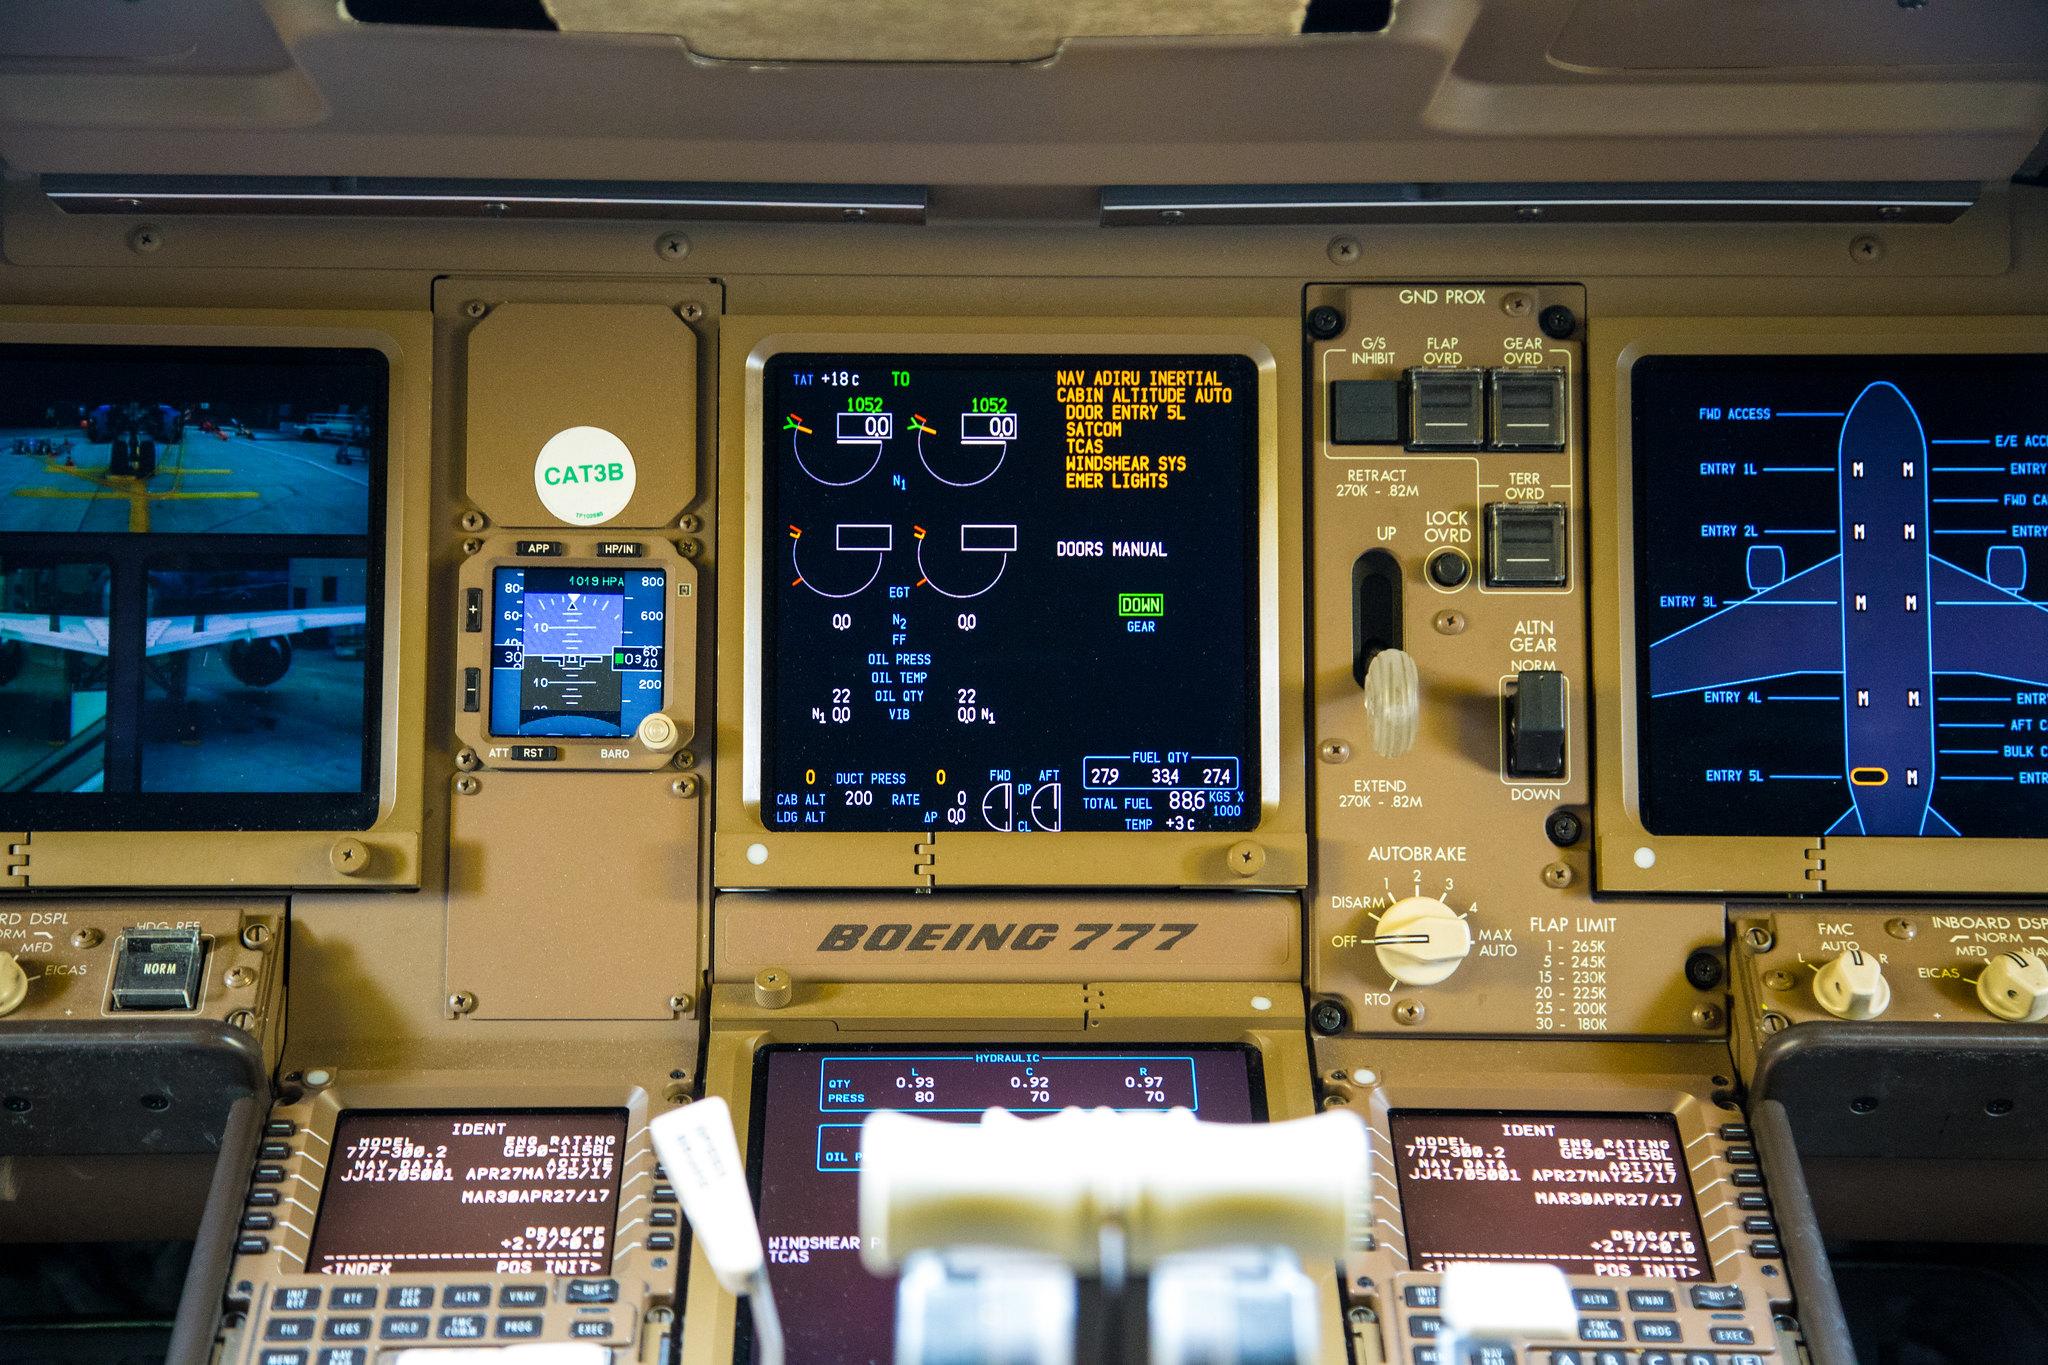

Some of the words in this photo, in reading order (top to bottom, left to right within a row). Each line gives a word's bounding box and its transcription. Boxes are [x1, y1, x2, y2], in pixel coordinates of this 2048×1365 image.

[1400, 290, 1437, 304] GND
[1446, 290, 1485, 304] PROX
[1362, 337, 1386, 349] G/S
[1427, 338, 1458, 349] FLAP
[1504, 338, 1542, 349] GEAR
[1352, 353, 1394, 364] INHIBIT
[1424, 353, 1462, 365] OVRD
[1504, 353, 1542, 365] OVRD
[794, 374, 813, 385] TAT
[892, 372, 910, 387] TO
[1057, 370, 1084, 385] NAV
[1094, 371, 1140, 385] ADIRU
[1150, 371, 1222, 386] INERTIAL
[1057, 388, 1103, 403] CABIN
[1112, 388, 1185, 403] ALTITUDE
[1195, 388, 1232, 403] AUTO
[1066, 405, 1103, 420] DOOR
[1112, 405, 1158, 420] ENTRY
[1167, 405, 1185, 420] 5L
[1700, 409, 1722, 419] FWD
[1728, 409, 1771, 419] ACCESS
[1066, 422, 1122, 437] SATCOM
[1066, 439, 1103, 454] TCAS
[1995, 435, 2018, 447] E/E
[1066, 456, 1149, 471] WINDSHEAR
[1158, 456, 1186, 471] SYS
[1700, 463, 1735, 475] ENTRY
[1744, 463, 1757, 475] 1L
[2010, 463, 2047, 475] ENTRY
[544, 463, 624, 486] CAT3B
[1348, 470, 1406, 481] RETRACT
[1509, 473, 1540, 484] TERR
[1066, 473, 1103, 488] EMER
[1112, 473, 1168, 488] LIGHTS
[1337, 485, 1367, 496] 270K
[1505, 488, 1544, 499] OVRD
[2004, 494, 2027, 506] FWD
[1426, 511, 1468, 525] LOCK
[1377, 527, 1396, 540] UP
[1424, 528, 1471, 542] OVRD
[1702, 526, 1736, 536] ENTRY
[1744, 526, 1758, 537] 2L
[528, 544, 549, 553] APP
[605, 545, 633, 554] HP/IN
[1057, 541, 1103, 556] DOORS
[1112, 542, 1167, 557] MANUAL
[569, 576, 599, 586] 1019
[602, 577, 624, 586] HPA
[641, 577, 664, 586] 800
[890, 587, 910, 597] EGT
[1122, 598, 1159, 612] DOWN
[1660, 596, 1695, 607] ENTRY
[1703, 596, 1717, 607] 3L
[641, 612, 663, 621] 600
[1127, 621, 1155, 632] GEAR
[1514, 621, 1554, 634] ALTN
[1510, 638, 1556, 652] GEAR
[868, 654, 889, 665] OIL
[896, 654, 931, 665] PRESS
[1511, 660, 1555, 671] NORM
[872, 673, 892, 683] OIL
[900, 673, 927, 683] TEMP
[639, 680, 661, 689] 200
[875, 691, 895, 701] OIL
[903, 691, 923, 701] QTY
[1704, 692, 1740, 703] ENTRY
[1747, 692, 1761, 703] 4L
[889, 709, 910, 720] VIB
[2011, 719, 2032, 731] AFT
[489, 749, 509, 757] ATT
[524, 749, 543, 757] RST
[601, 749, 629, 758] BARO
[2004, 746, 2034, 757] BULK
[1133, 752, 1160, 763] FUEL
[1168, 752, 1189, 763] QTY
[836, 773, 864, 784] DUCT
[871, 773, 906, 784] PRESS
[990, 770, 1010, 780] FWD
[1039, 770, 1059, 780] AFT
[1706, 770, 1741, 781] ENTRY
[1749, 770, 1763, 781] 5L
[1354, 780, 1407, 792] EXTEND
[777, 794, 797, 805] CAB
[805, 794, 825, 805] ALT
[845, 791, 872, 805] 200
[892, 794, 920, 805] RATE
[1209, 792, 1230, 802] KGS
[1511, 789, 1560, 800] DOWN
[1083, 798, 1117, 809] TOTAL
[1125, 798, 1152, 809] FUEL
[1339, 796, 1370, 807] 270K
[1213, 806, 1241, 816] 1000
[777, 812, 797, 822] LDG
[805, 812, 825, 822] ALT
[1125, 819, 1152, 830] TEMP
[1368, 847, 1466, 862] AUTOBRAKE
[1332, 896, 1385, 908] DISARM
[30, 913, 68, 924] DSPL
[1932, 917, 2010, 929] INBOARD
[1530, 917, 1568, 932] FLAP
[1577, 918, 1616, 932] LIMIT
[1818, 924, 1854, 936] FMC
[817, 924, 1059, 951] BOEING
[1069, 924, 1199, 950] 777
[1479, 929, 1512, 941] MAX
[1975, 933, 2023, 942] NORM
[1332, 936, 1357, 947] OFF
[1572, 941, 1605, 953] 265K
[1821, 941, 1859, 951] AUTO
[21, 943, 52, 952] MFD
[1480, 945, 1517, 957] AUTO
[1956, 946, 1987, 956] MFD
[1572, 956, 1605, 968] 245K
[45, 965, 87, 975] EICAS
[144, 963, 176, 974] NORM
[1919, 968, 1960, 979] EICAS
[1539, 971, 1552, 983] 15
[1573, 972, 1605, 984] 230K
[1535, 987, 1552, 999] 20
[1573, 987, 1606, 999] 225K
[1365, 994, 1391, 1005] RTO
[1536, 1002, 1552, 1014] 25
[1573, 1003, 1607, 1014] 200K
[1536, 1018, 1553, 1030] 30
[1578, 1018, 1607, 1030] 180K
[976, 1054, 1040, 1063] HYDRAULIC
[829, 1080, 851, 1089] QTY
[896, 1077, 935, 1088] 0.93
[1011, 1077, 1049, 1088] 0.92
[1125, 1077, 1163, 1088] 0.97
[828, 1094, 864, 1102] PRESS
[452, 1123, 506, 1136] IDENT
[1502, 1124, 1555, 1137] IDENT
[360, 1137, 413, 1147] MODEL
[505, 1136, 537, 1146] ENG
[550, 1136, 615, 1146] RATING
[347, 1146, 447, 1159] 777-300.2
[504, 1144, 614, 1157] GE90-115BL
[1405, 1145, 1506, 1158] 777-300.2
[1560, 1148, 1673, 1160] GE90-115BL
[466, 1167, 612, 1180] APR27MAY25/17
[1532, 1169, 1676, 1183] APR27MAY25/17
[462, 1189, 610, 1204] MAR30APR27/17
[1535, 1192, 1682, 1207] MAR30APR27/17
[769, 1236, 860, 1250] WINDSHEAR
[769, 1250, 809, 1263] TCAS
[1638, 1296, 1664, 1305] VNAV
[1643, 1326, 1672, 1337] PROG
